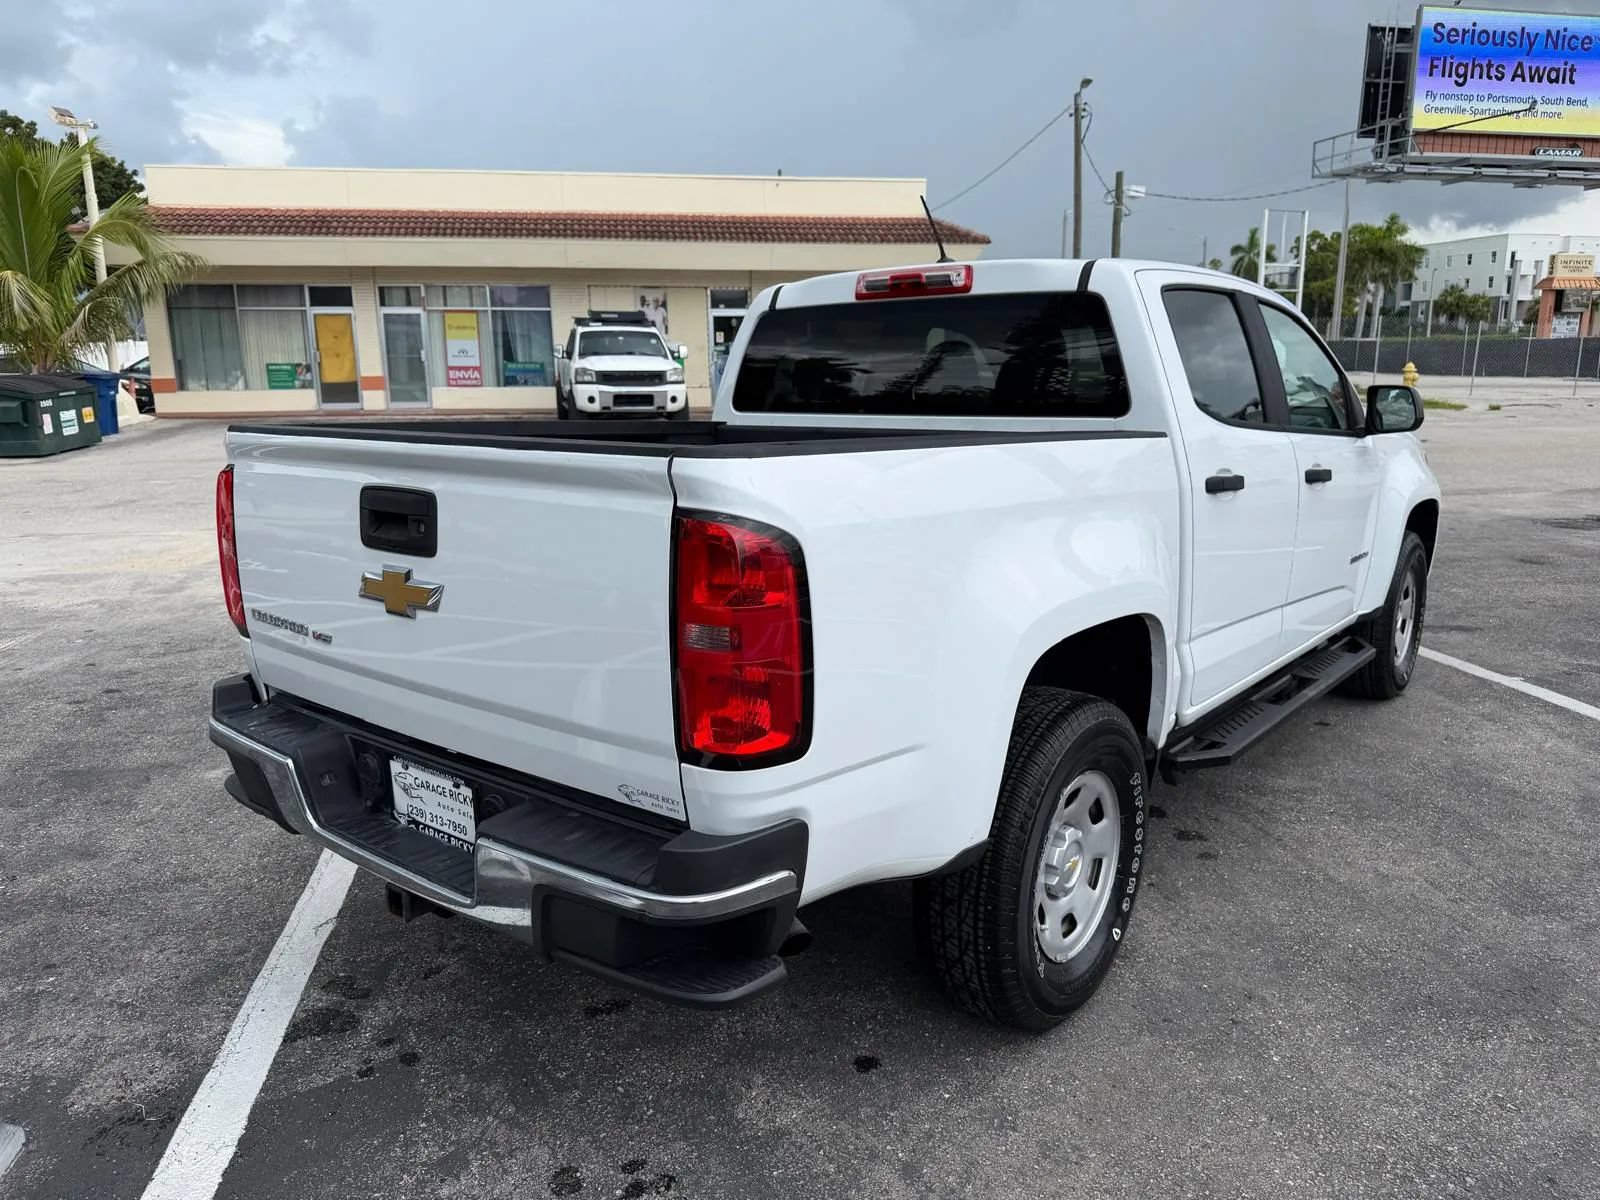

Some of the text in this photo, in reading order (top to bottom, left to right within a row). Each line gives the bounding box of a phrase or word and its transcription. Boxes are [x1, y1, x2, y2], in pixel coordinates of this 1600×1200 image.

[1432, 22, 1594, 56] Seriously Nice
[1428, 56, 1577, 87] Flights Await
[1425, 90, 1438, 102] Fly
[1440, 92, 1474, 103] nonstop
[1476, 93, 1485, 102] to
[1540, 95, 1564, 106] South
[1566, 97, 1589, 108] Bend,
[1540, 110, 1564, 119] more.
[1539, 149, 1581, 157] LAMAR
[449, 369, 480, 379] ENVÍA
[413, 777, 474, 809] GARAGE RICKY
[637, 789, 679, 807] GARAGE RICKY
[437, 801, 455, 813] Auto
[406, 803, 468, 836] (239) 313-7950
[418, 825, 474, 854] GARAGE RICKY
[1122, 772, 1144, 912] Firestone
